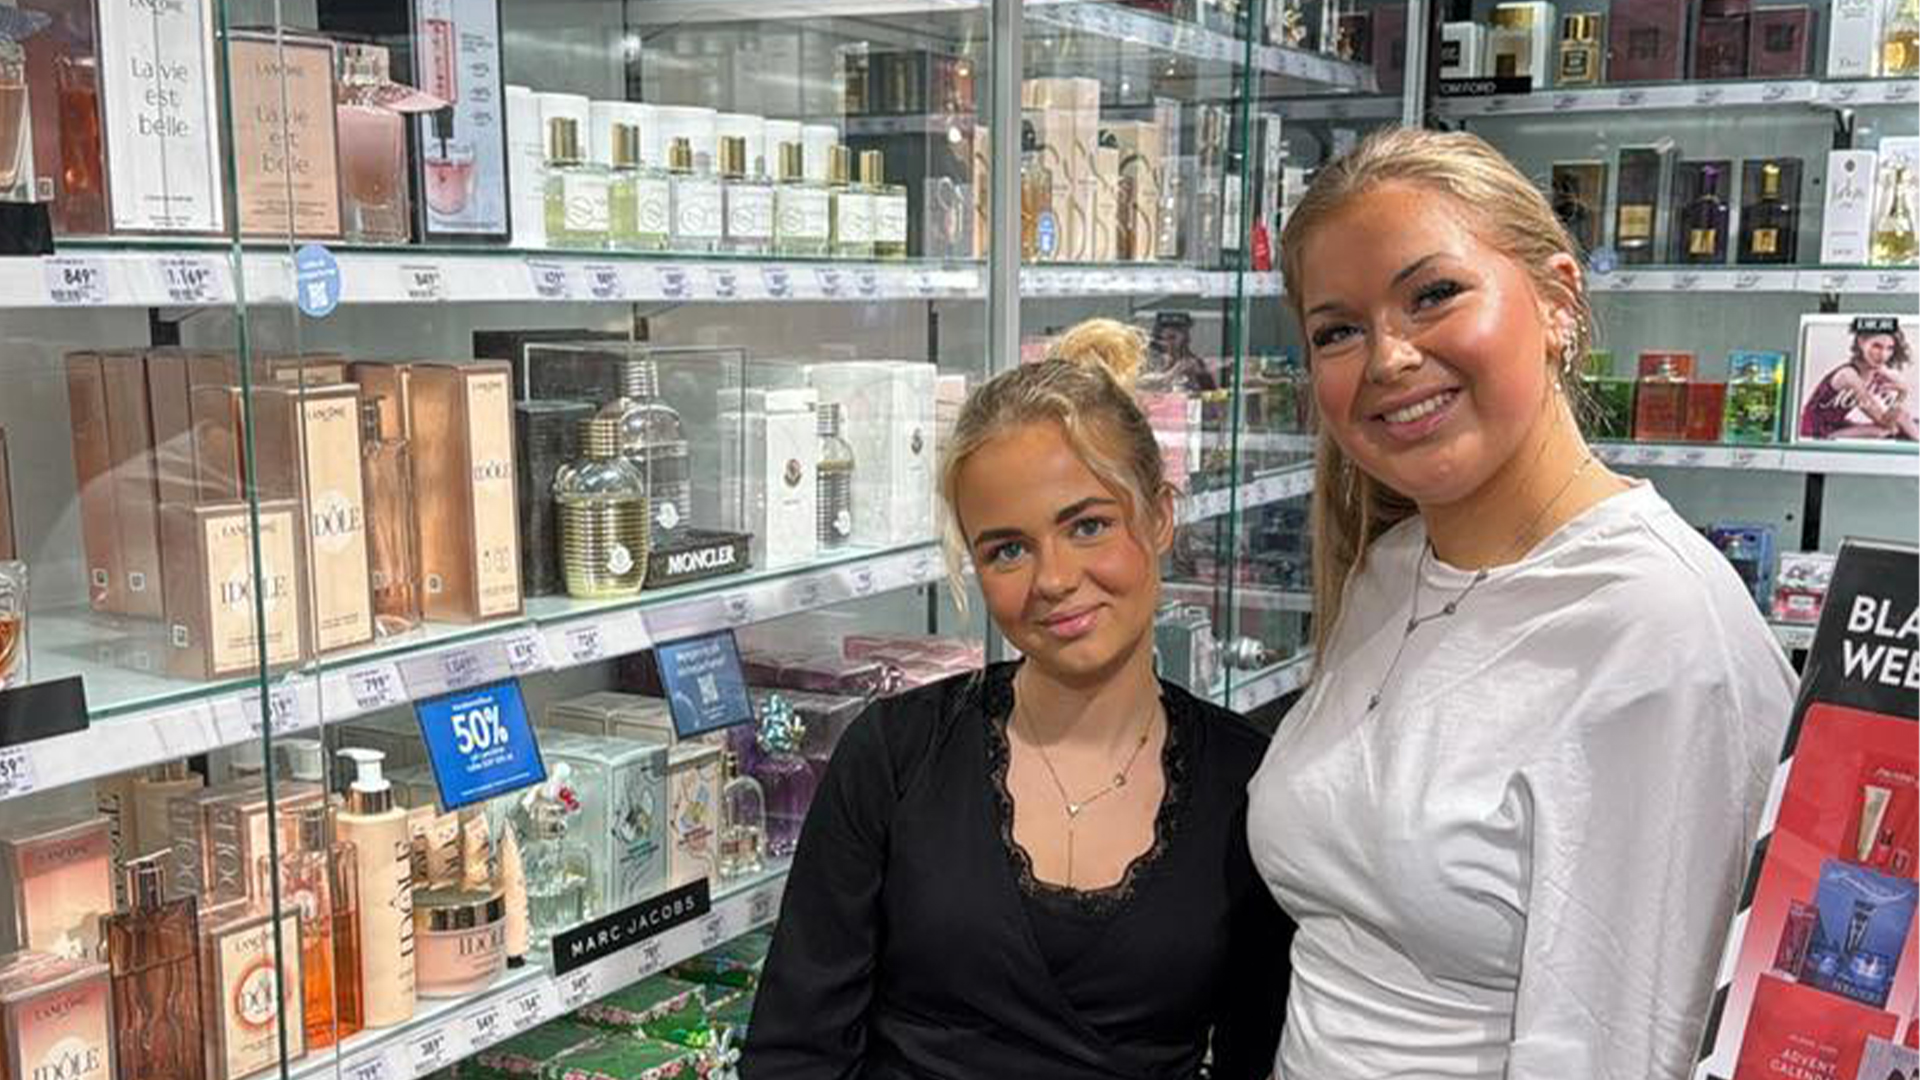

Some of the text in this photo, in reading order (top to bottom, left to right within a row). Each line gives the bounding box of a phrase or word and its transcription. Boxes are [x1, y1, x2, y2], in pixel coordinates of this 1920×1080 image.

[139, 113, 188, 137] belle
[667, 545, 735, 574] MONCLER
[452, 705, 508, 755] 50%
[571, 895, 697, 957] MARC JACOBS
